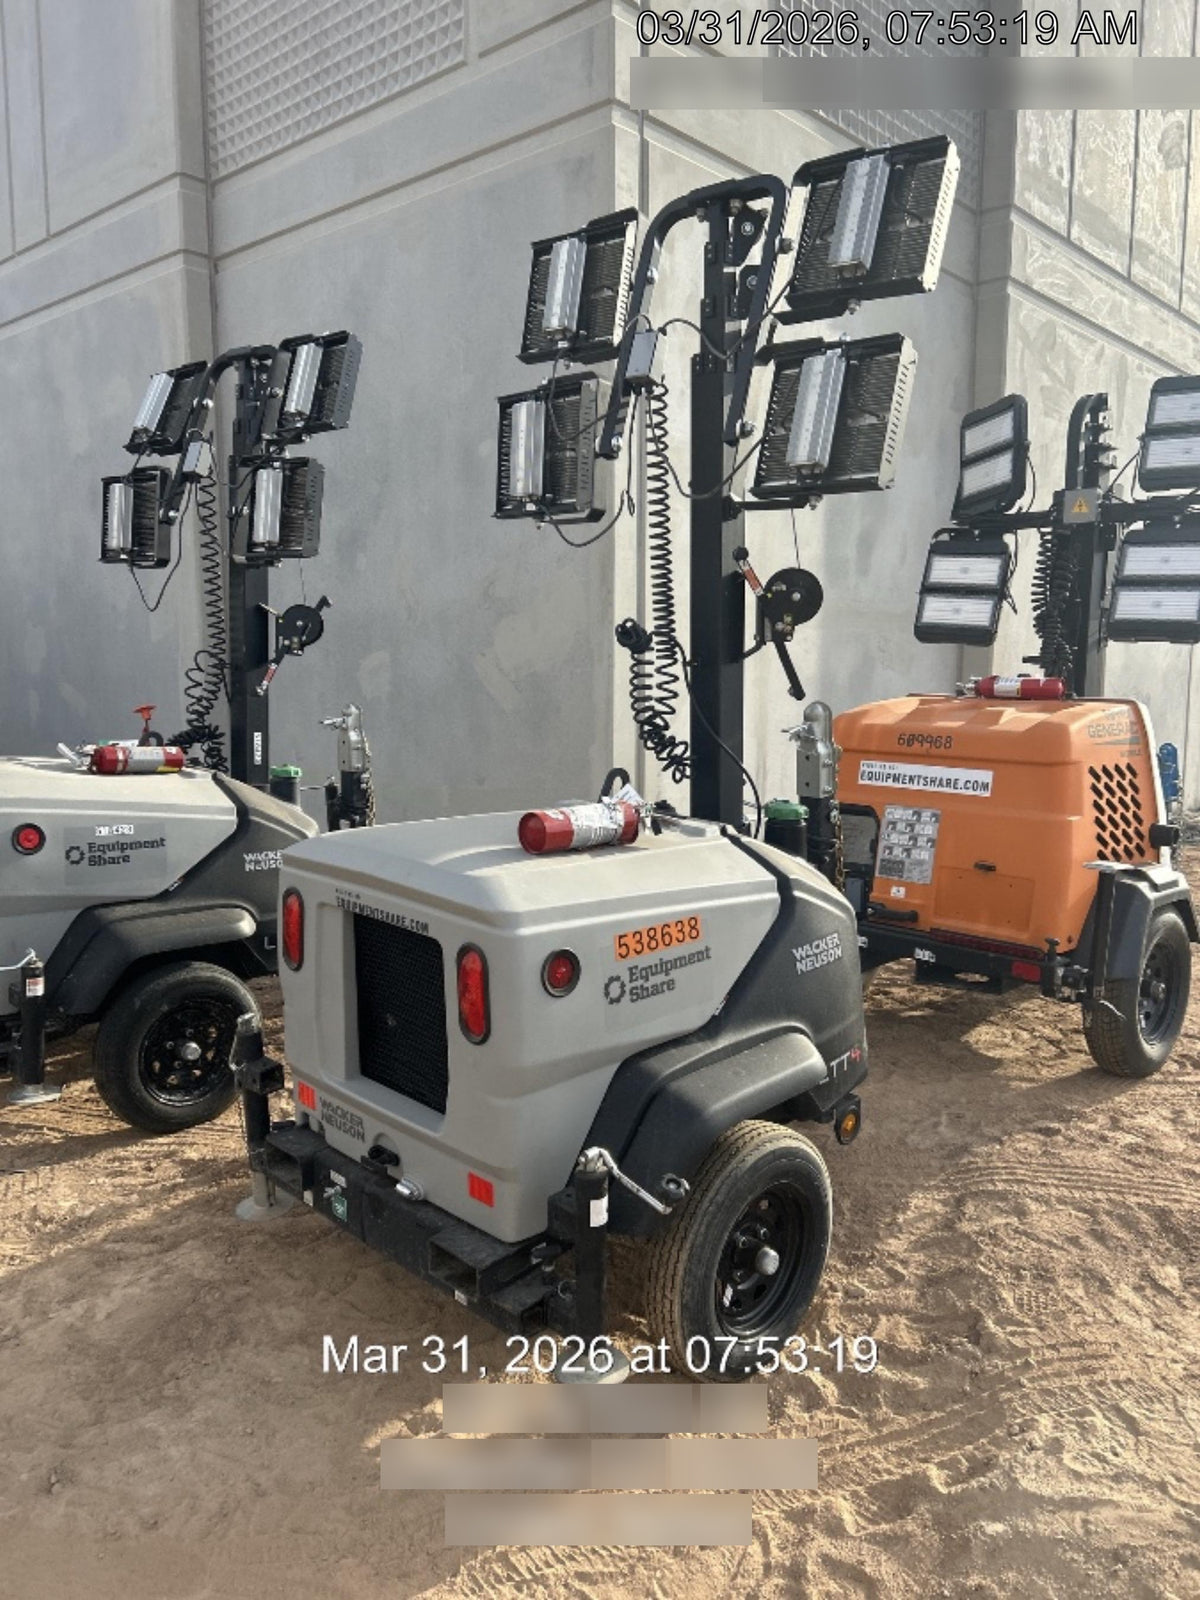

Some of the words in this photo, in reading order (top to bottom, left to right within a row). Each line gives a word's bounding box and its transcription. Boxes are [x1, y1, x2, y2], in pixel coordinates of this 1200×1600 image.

[897, 732, 953, 750] 609968
[860, 770, 990, 793] EQUIPMENTSHARE.COM
[87, 837, 166, 854] Equipment
[243, 850, 283, 862] WACKE
[87, 854, 131, 867] Share
[245, 859, 284, 871] NEUSO
[617, 916, 700, 959] 538638
[792, 933, 840, 960] WACKER
[627, 945, 711, 984] Equipment
[795, 947, 842, 975] NEUSON
[628, 977, 675, 1003] Share
